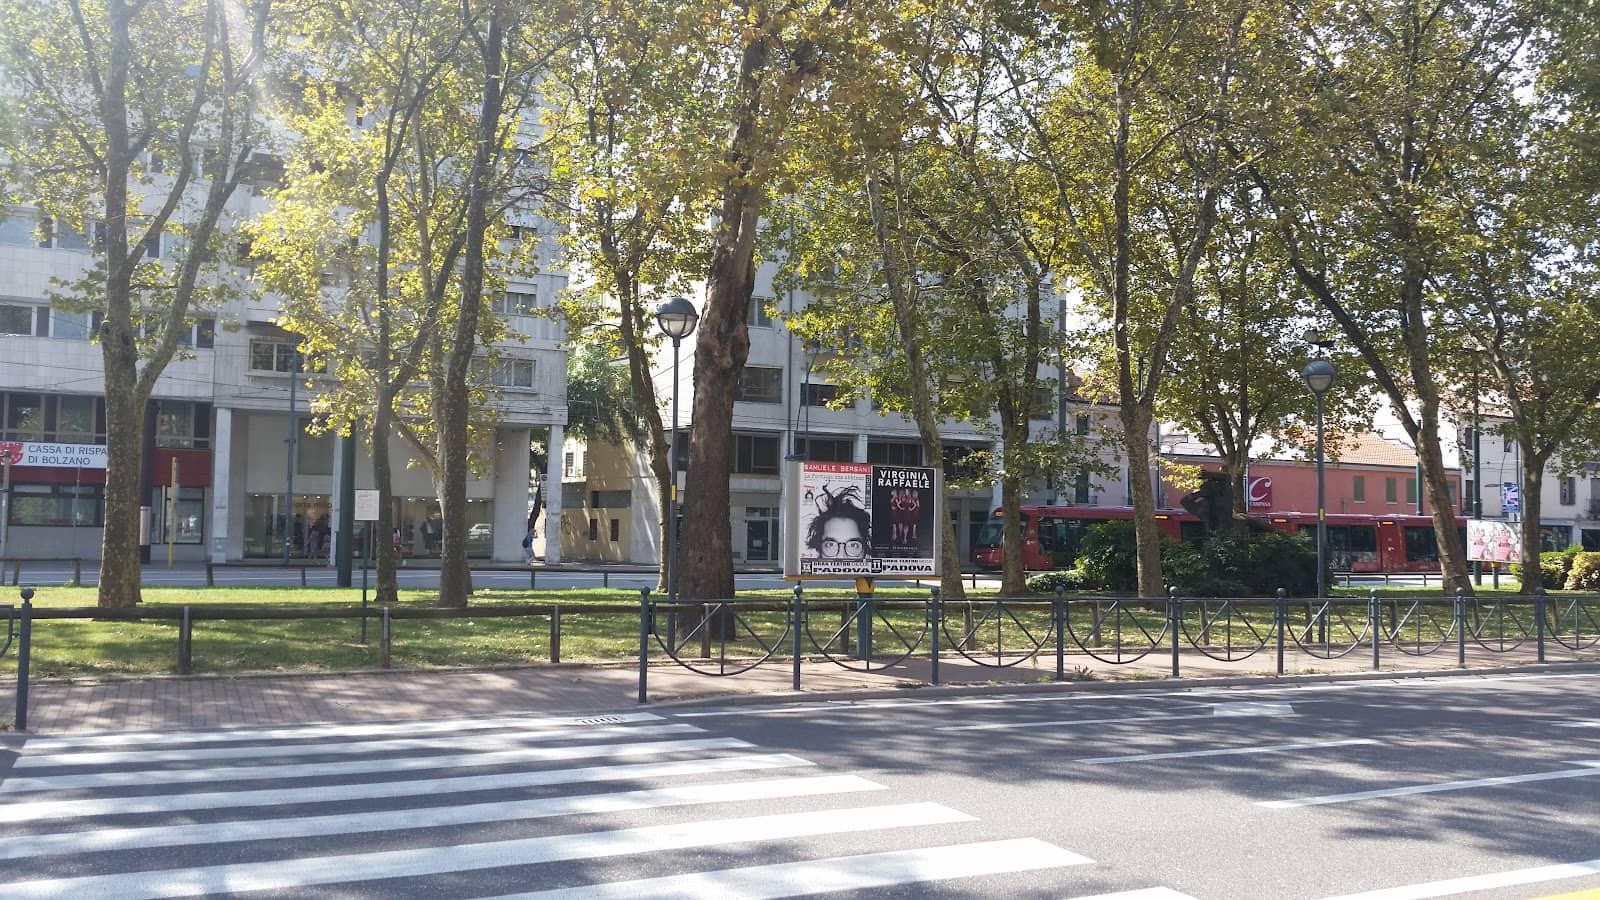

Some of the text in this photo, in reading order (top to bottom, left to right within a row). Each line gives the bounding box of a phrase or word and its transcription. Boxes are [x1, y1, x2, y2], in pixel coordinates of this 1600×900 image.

[28, 445, 62, 455] CASSA
[65, 446, 75, 455] DI
[28, 455, 91, 465] DI BOLZANO
[804, 464, 871, 473] SAMUELE BERSANI
[880, 470, 929, 481] VIRGINIA
[878, 479, 930, 489] RAFFAELE
